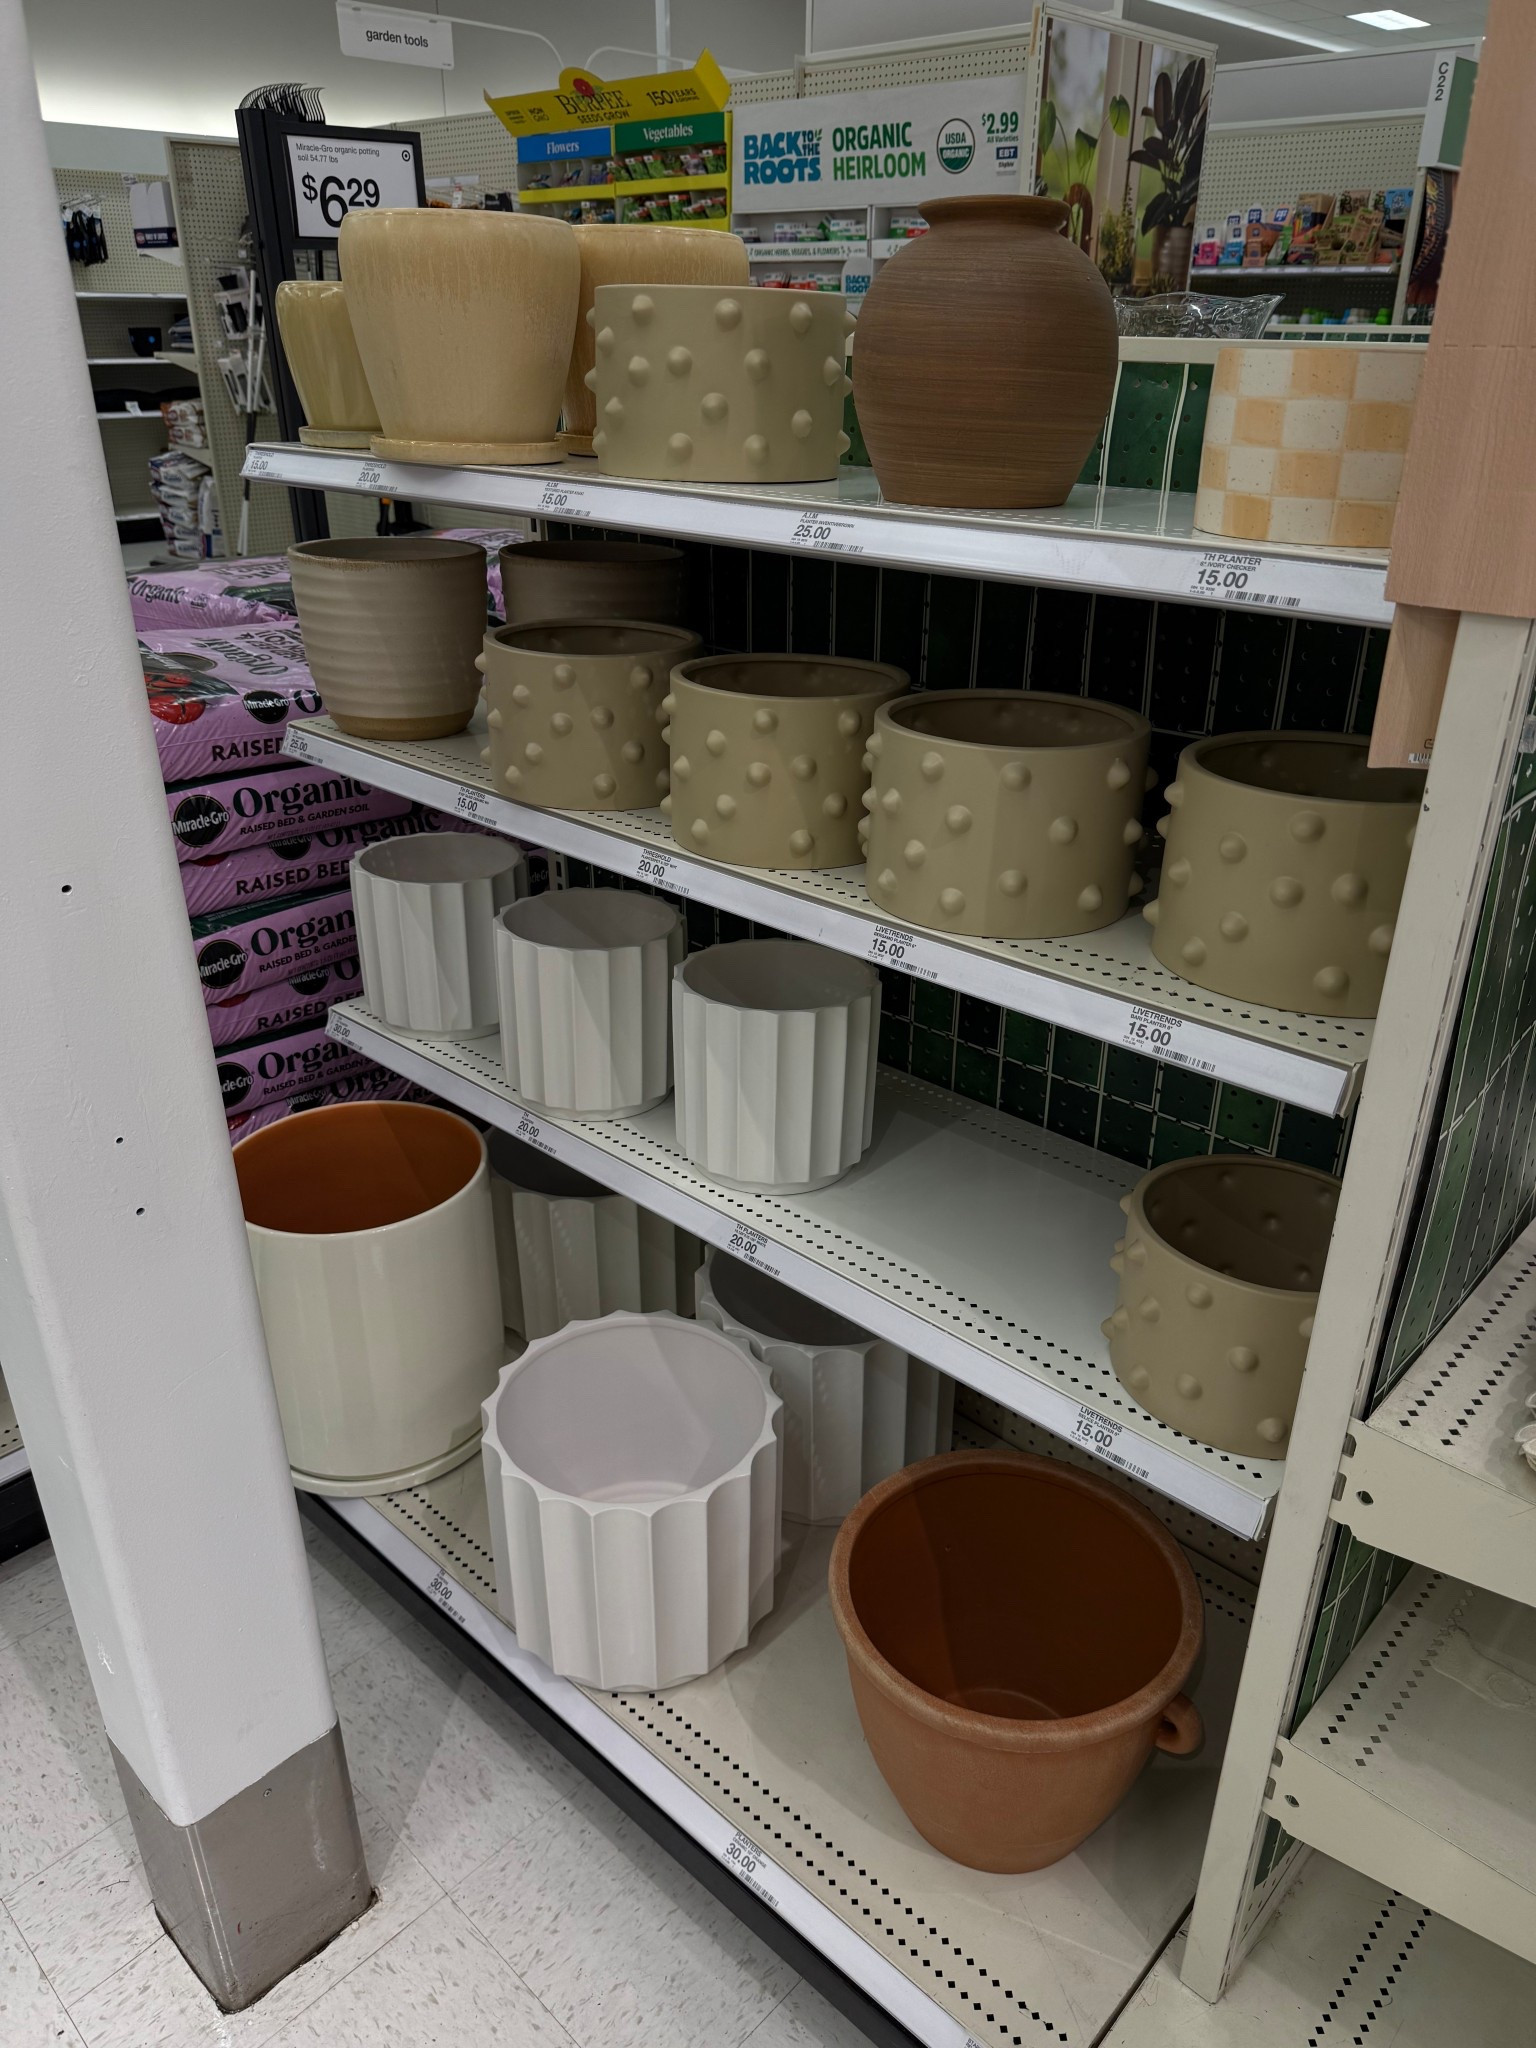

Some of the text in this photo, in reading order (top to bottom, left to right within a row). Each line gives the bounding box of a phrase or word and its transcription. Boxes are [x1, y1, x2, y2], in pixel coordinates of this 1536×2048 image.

[366, 30, 429, 48] garden tools
[1435, 61, 1449, 101] C22
[554, 90, 632, 115] BURPEE
[646, 90, 674, 106] 150
[670, 88, 696, 97] YEARS
[577, 110, 631, 125] SEEDS GROW
[982, 111, 1019, 134] $2.99
[643, 124, 693, 143] Vegetables
[832, 121, 912, 152] ORGANIC
[945, 132, 967, 144] USDA
[296, 142, 380, 157] Miracle-Gro organic potting
[546, 142, 580, 155] Flowers
[744, 130, 820, 160] BACK TO THE
[943, 148, 970, 159] ORGANIC
[999, 149, 1015, 157] EBT
[298, 154, 338, 163] soil 54.77 lbs
[833, 151, 926, 181] HEIRLOOM
[744, 157, 821, 185] ROOTS
[250, 460, 268, 470] 15.00
[358, 472, 381, 483] 20.00
[541, 492, 568, 506] 15.00
[793, 524, 831, 540] 25.00
[1203, 553, 1262, 565] TH PLANTER
[1226, 563, 1256, 572] CHECKER
[1198, 568, 1248, 589] 15.00
[242, 697, 290, 712] Miracle-Gro
[290, 738, 308, 752] 25.00
[233, 775, 372, 818] Organic
[457, 796, 478, 812] 15.00
[171, 811, 230, 836] Miracle-Gro
[239, 821, 275, 835] RAISED
[277, 817, 296, 829] BED
[307, 806, 348, 821] GARDEN
[348, 803, 370, 814] SOIL
[643, 848, 672, 863] THRESHOLD
[638, 859, 665, 878] 20.00
[236, 866, 310, 895] RAISED
[251, 909, 356, 956] Organ
[875, 925, 914, 942] LIVETRENDS
[893, 938, 912, 947] PLANTER
[872, 938, 905, 959] 15.00
[200, 951, 249, 978] Miracle-Gro
[259, 955, 293, 973] RAISED
[294, 949, 312, 962] BED
[257, 1001, 328, 1030] RAISED
[1132, 1006, 1183, 1028] LIVETRENDS
[1143, 1017, 1167, 1030] PLANTER
[333, 1023, 350, 1038] 30.00
[1129, 1021, 1172, 1046] 15.00
[257, 1041, 354, 1080] Orga
[221, 1073, 254, 1093] cle-Gro
[263, 1060, 364, 1096] RAISED BED & GARDEN
[330, 1066, 399, 1099] Orga
[517, 1120, 540, 1137] 20.00
[730, 1233, 757, 1255] 20.00
[743, 1227, 768, 1244] PLANTERS
[1080, 1406, 1123, 1433] LIVETRENDS
[1093, 1420, 1116, 1434] PLANTER
[1076, 1419, 1113, 1448] 15.00
[430, 1578, 453, 1600] 30.00
[735, 1831, 762, 1857] PLANTERS
[726, 1842, 756, 1873] 30.00
